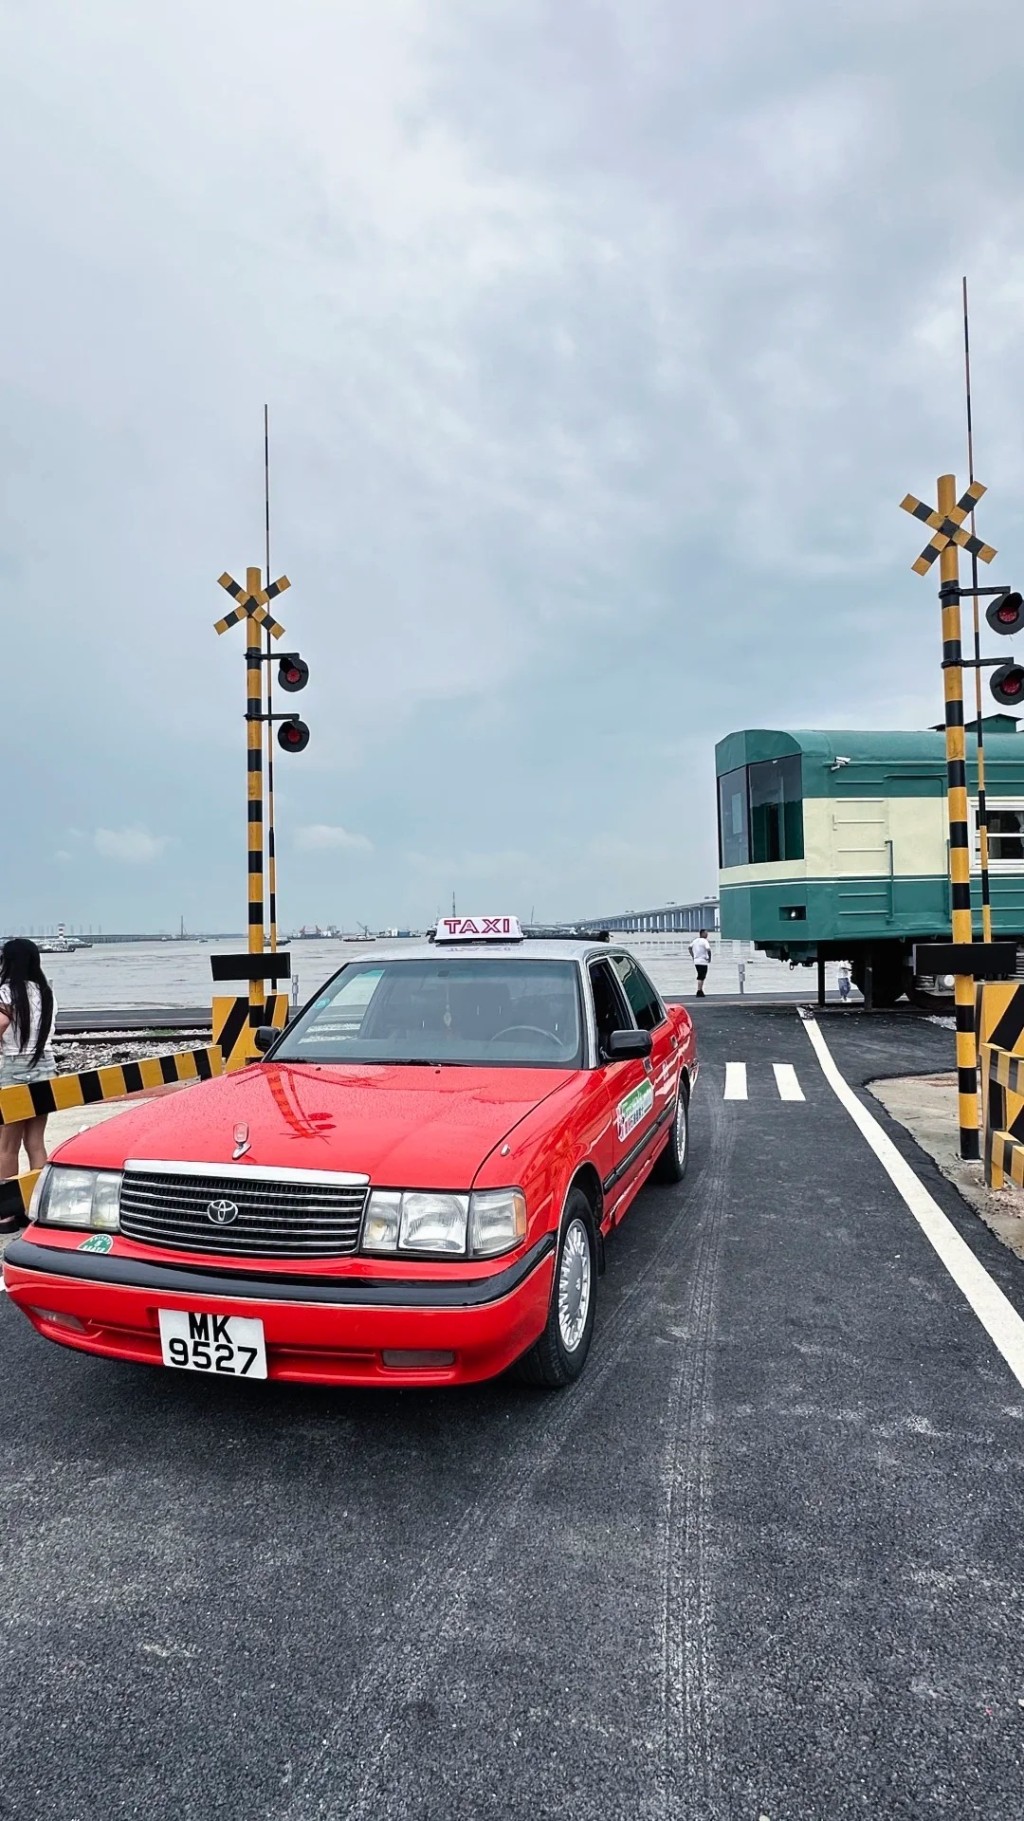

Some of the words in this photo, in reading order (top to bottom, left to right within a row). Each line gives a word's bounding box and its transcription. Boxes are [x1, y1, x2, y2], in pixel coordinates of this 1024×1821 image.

[444, 919, 510, 934] TAXI
[188, 1312, 233, 1344] MK
[169, 1338, 258, 1375] 9527
